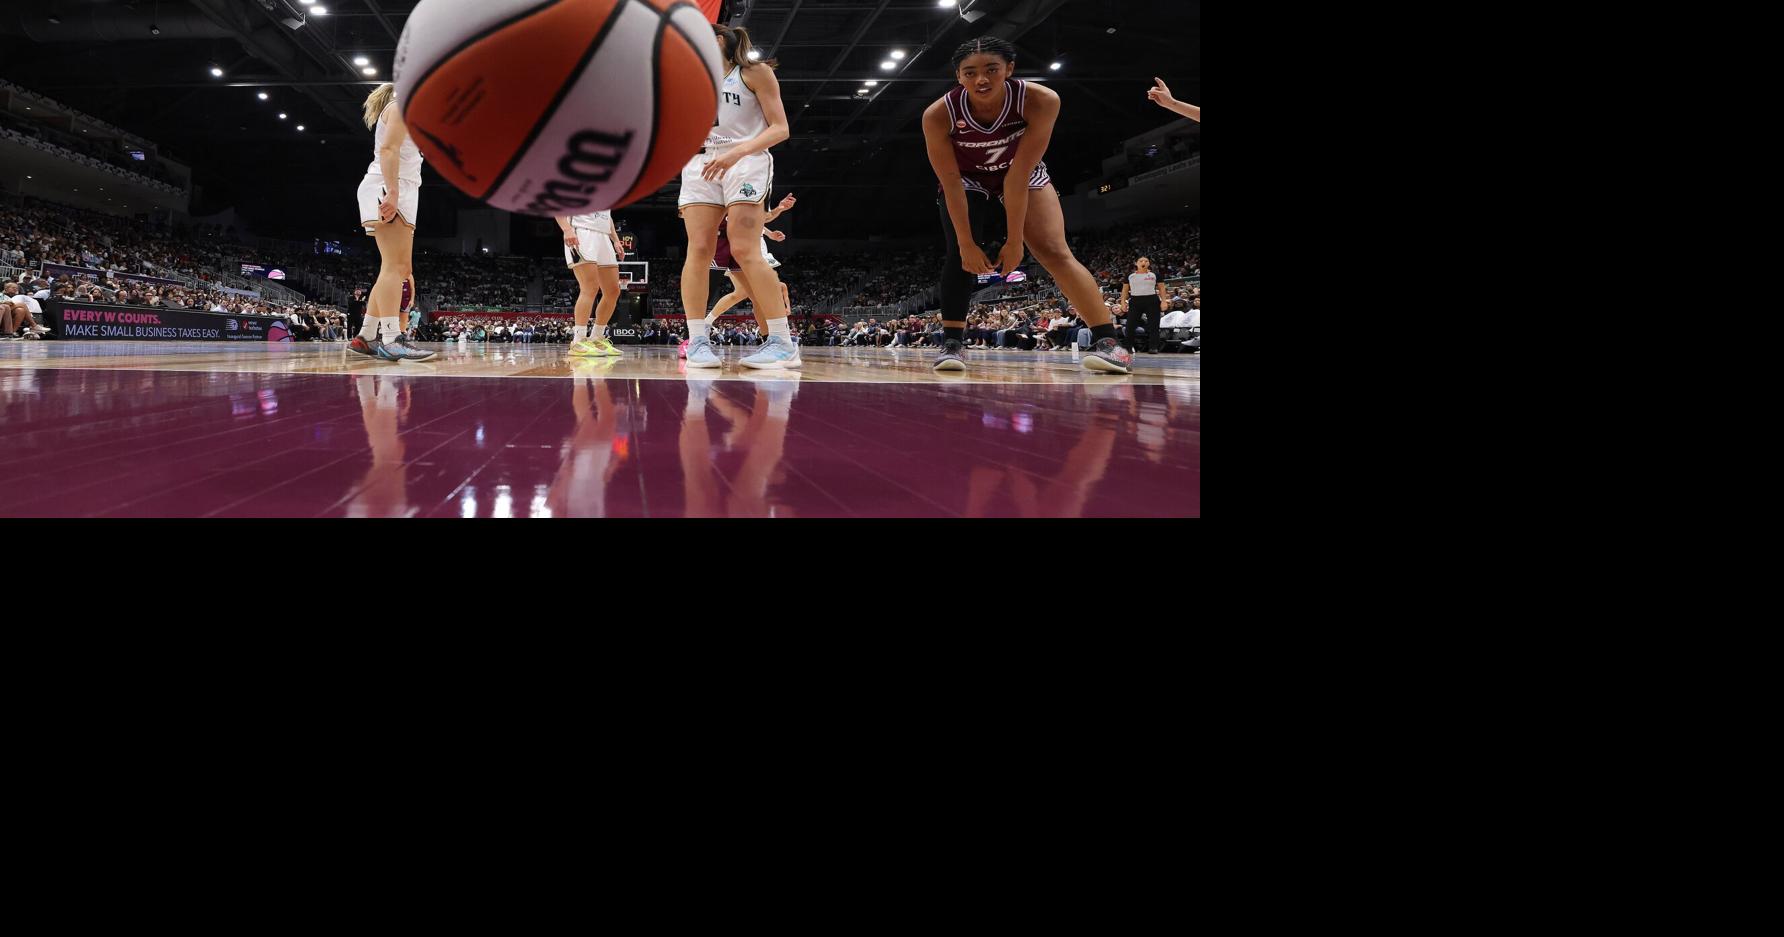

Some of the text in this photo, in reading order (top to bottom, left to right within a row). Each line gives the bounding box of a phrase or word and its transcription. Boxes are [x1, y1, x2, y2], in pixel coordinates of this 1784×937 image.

[983, 145, 1008, 165] 7
[63, 309, 161, 324] EVERY W COUNTS.
[65, 324, 98, 336] MAKE
[100, 325, 134, 337] SMALL
[135, 326, 176, 338] BUSINESS
[178, 327, 201, 338] TAXES
[202, 328, 220, 339] EASY.
